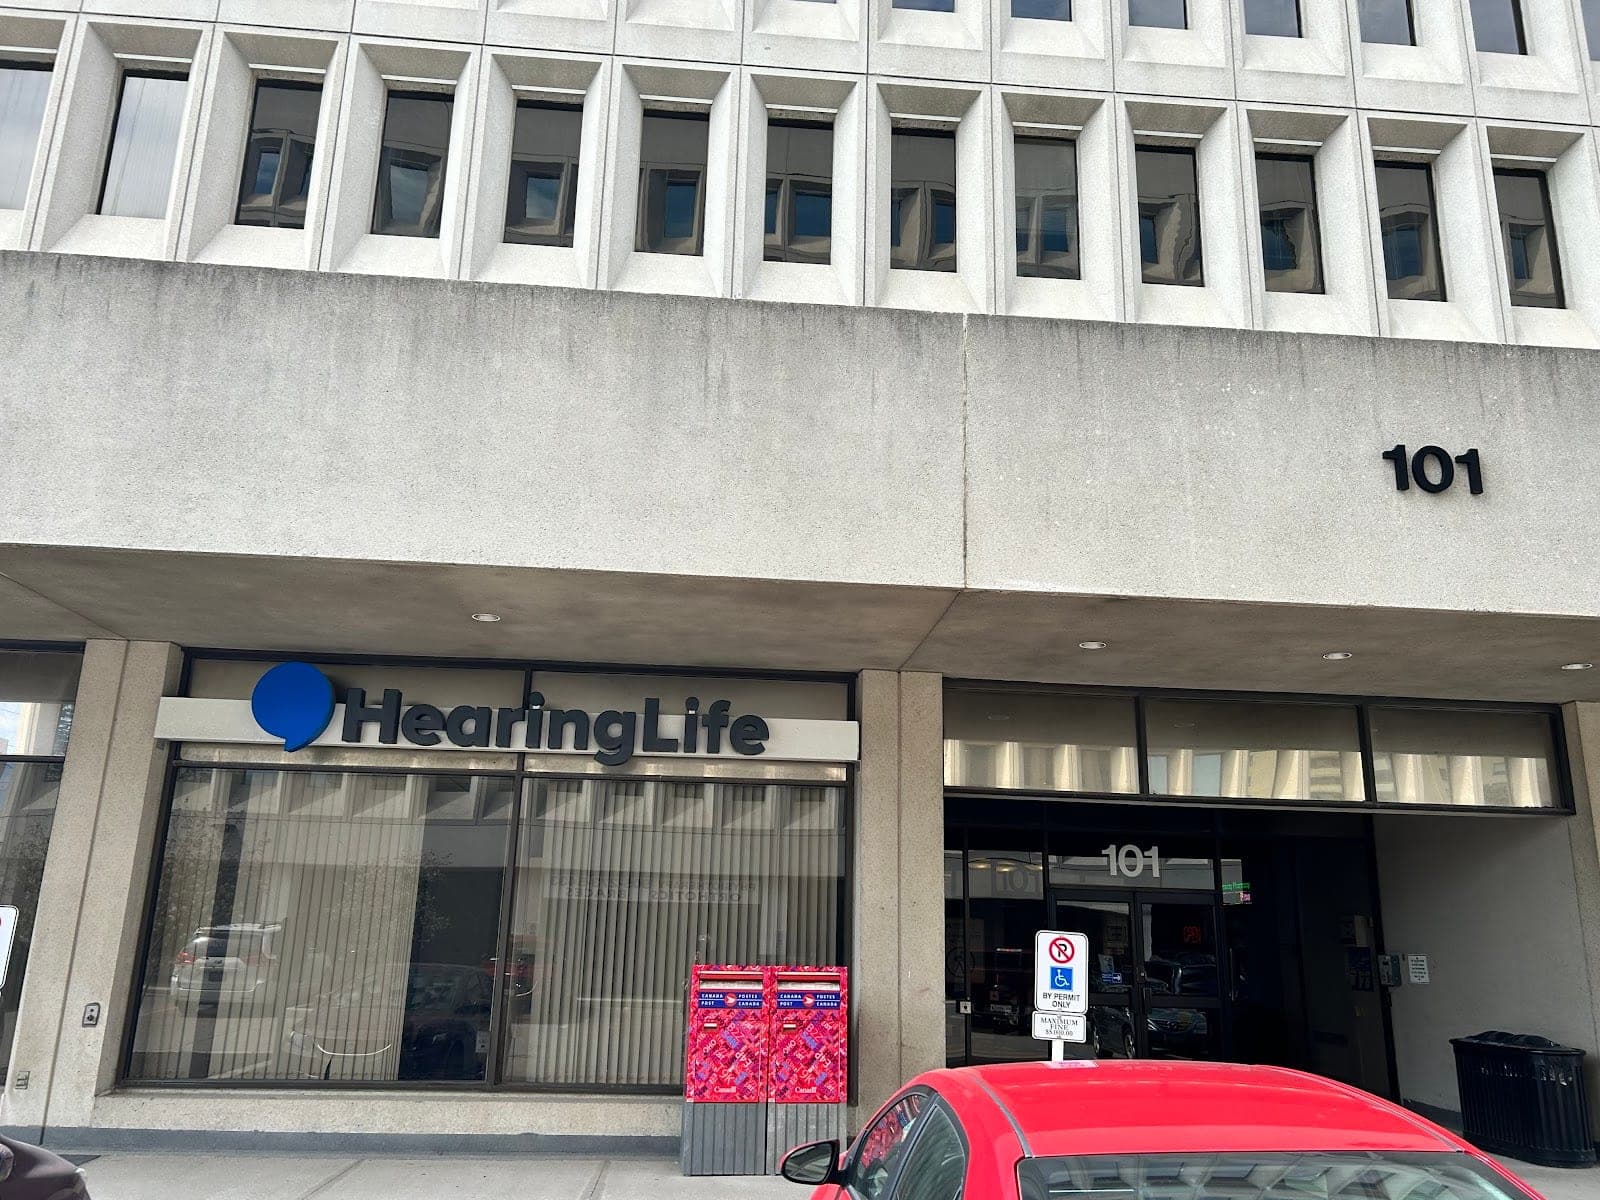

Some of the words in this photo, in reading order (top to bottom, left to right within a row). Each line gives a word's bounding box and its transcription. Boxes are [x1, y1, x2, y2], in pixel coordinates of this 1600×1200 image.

[1382, 444, 1483, 494] 101
[342, 688, 769, 766] HearingLife
[1102, 844, 1160, 877] 101
[1053, 993, 1080, 1001] PERMIT
[1052, 1000, 1071, 1008] ONLY
[1041, 1017, 1078, 1026] MAXIMUM
[1050, 1023, 1069, 1031] FINE
